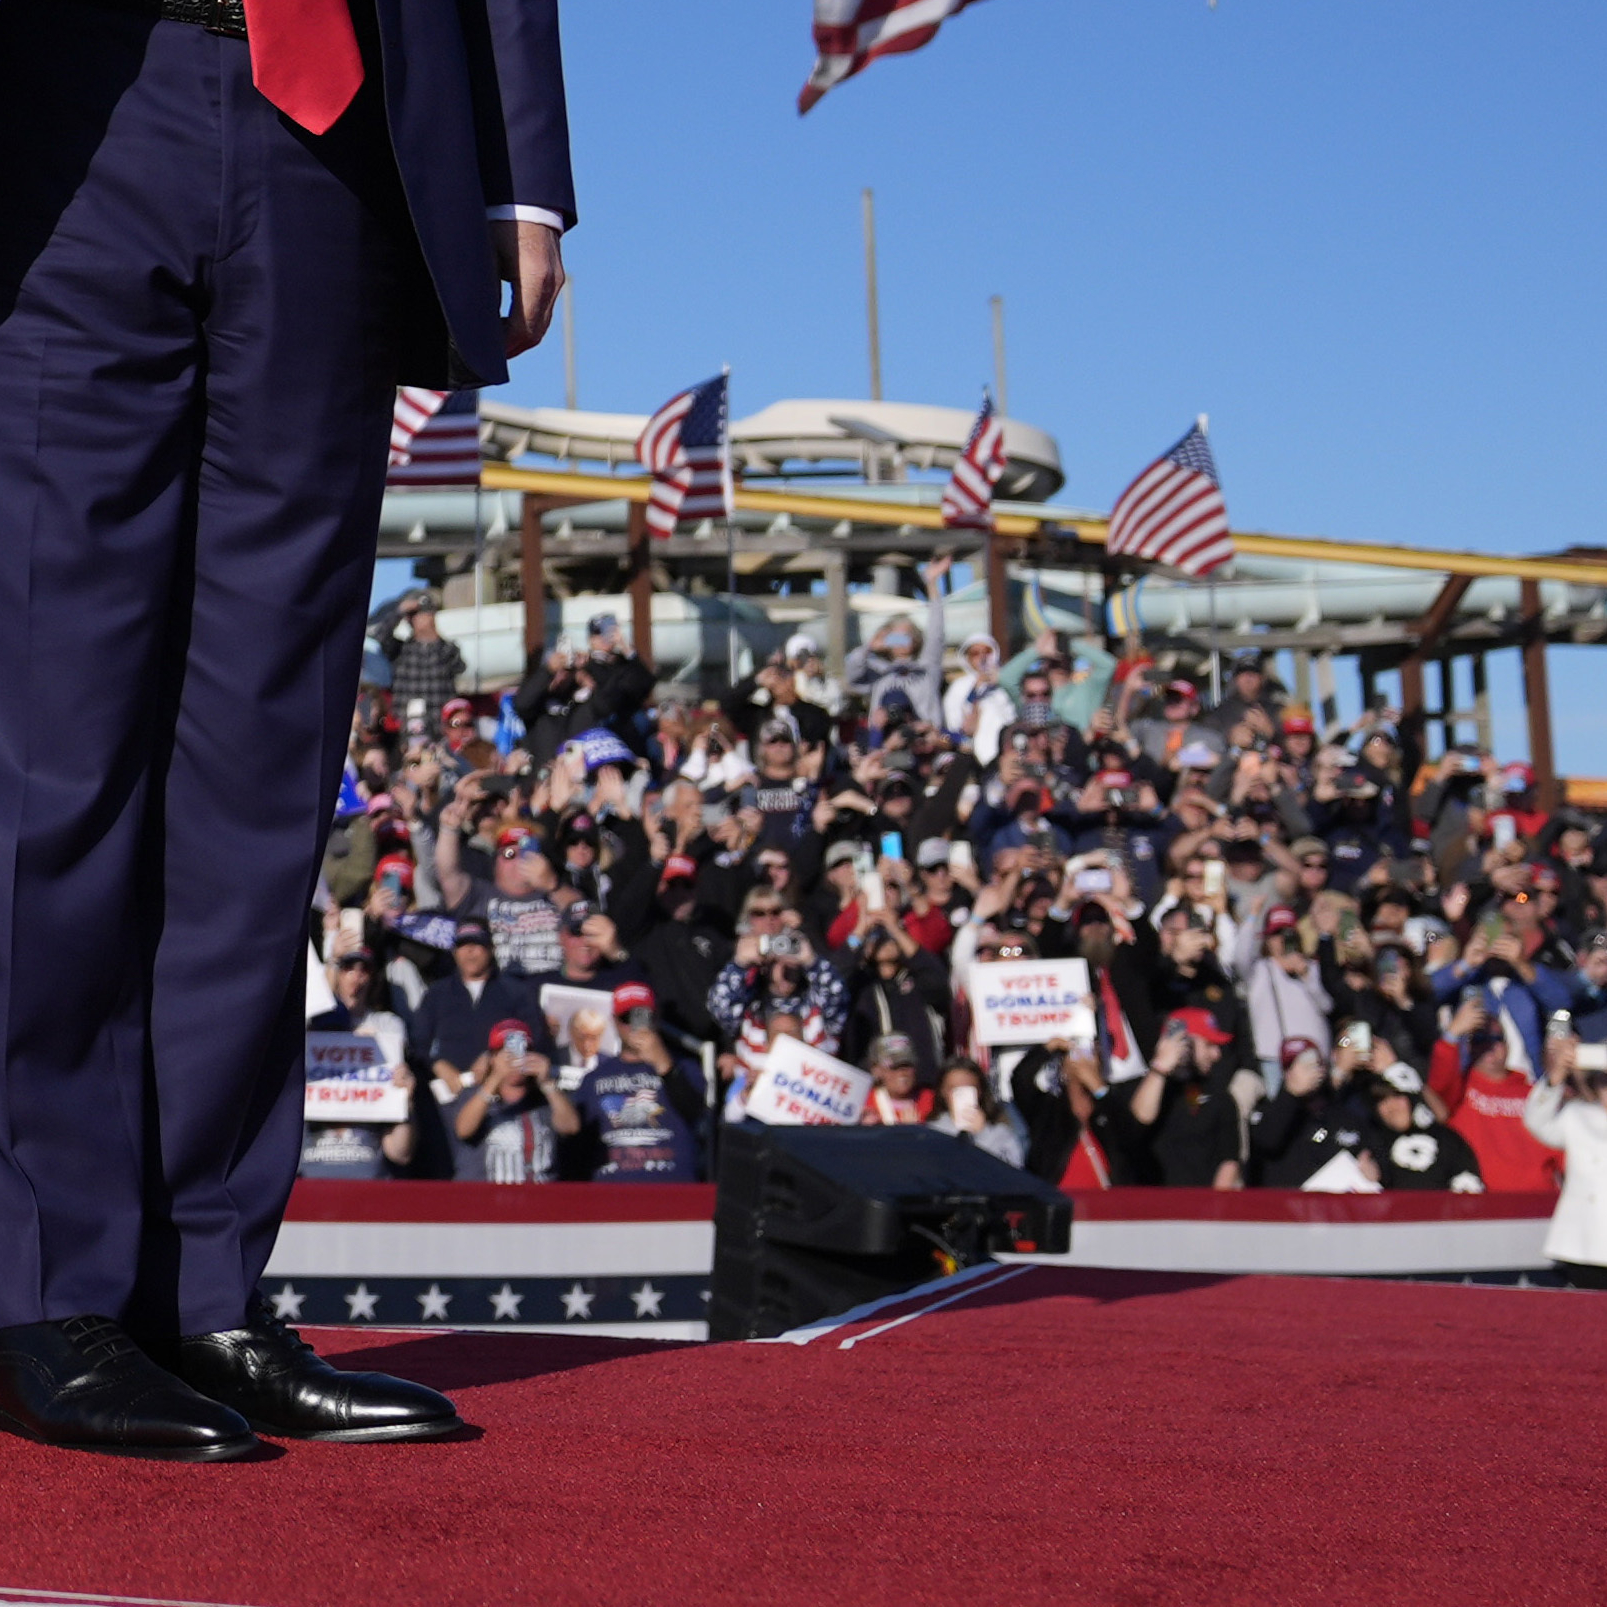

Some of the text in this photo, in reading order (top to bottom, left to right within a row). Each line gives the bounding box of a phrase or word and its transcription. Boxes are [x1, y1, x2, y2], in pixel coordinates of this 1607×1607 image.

[1000, 974, 1059, 990] VOTE
[985, 991, 1079, 1011] DONALD
[995, 1009, 1072, 1028] TRUMP
[311, 1046, 375, 1064] VOTE
[800, 1061, 852, 1095] VOTE
[774, 1073, 854, 1117] DONALD
